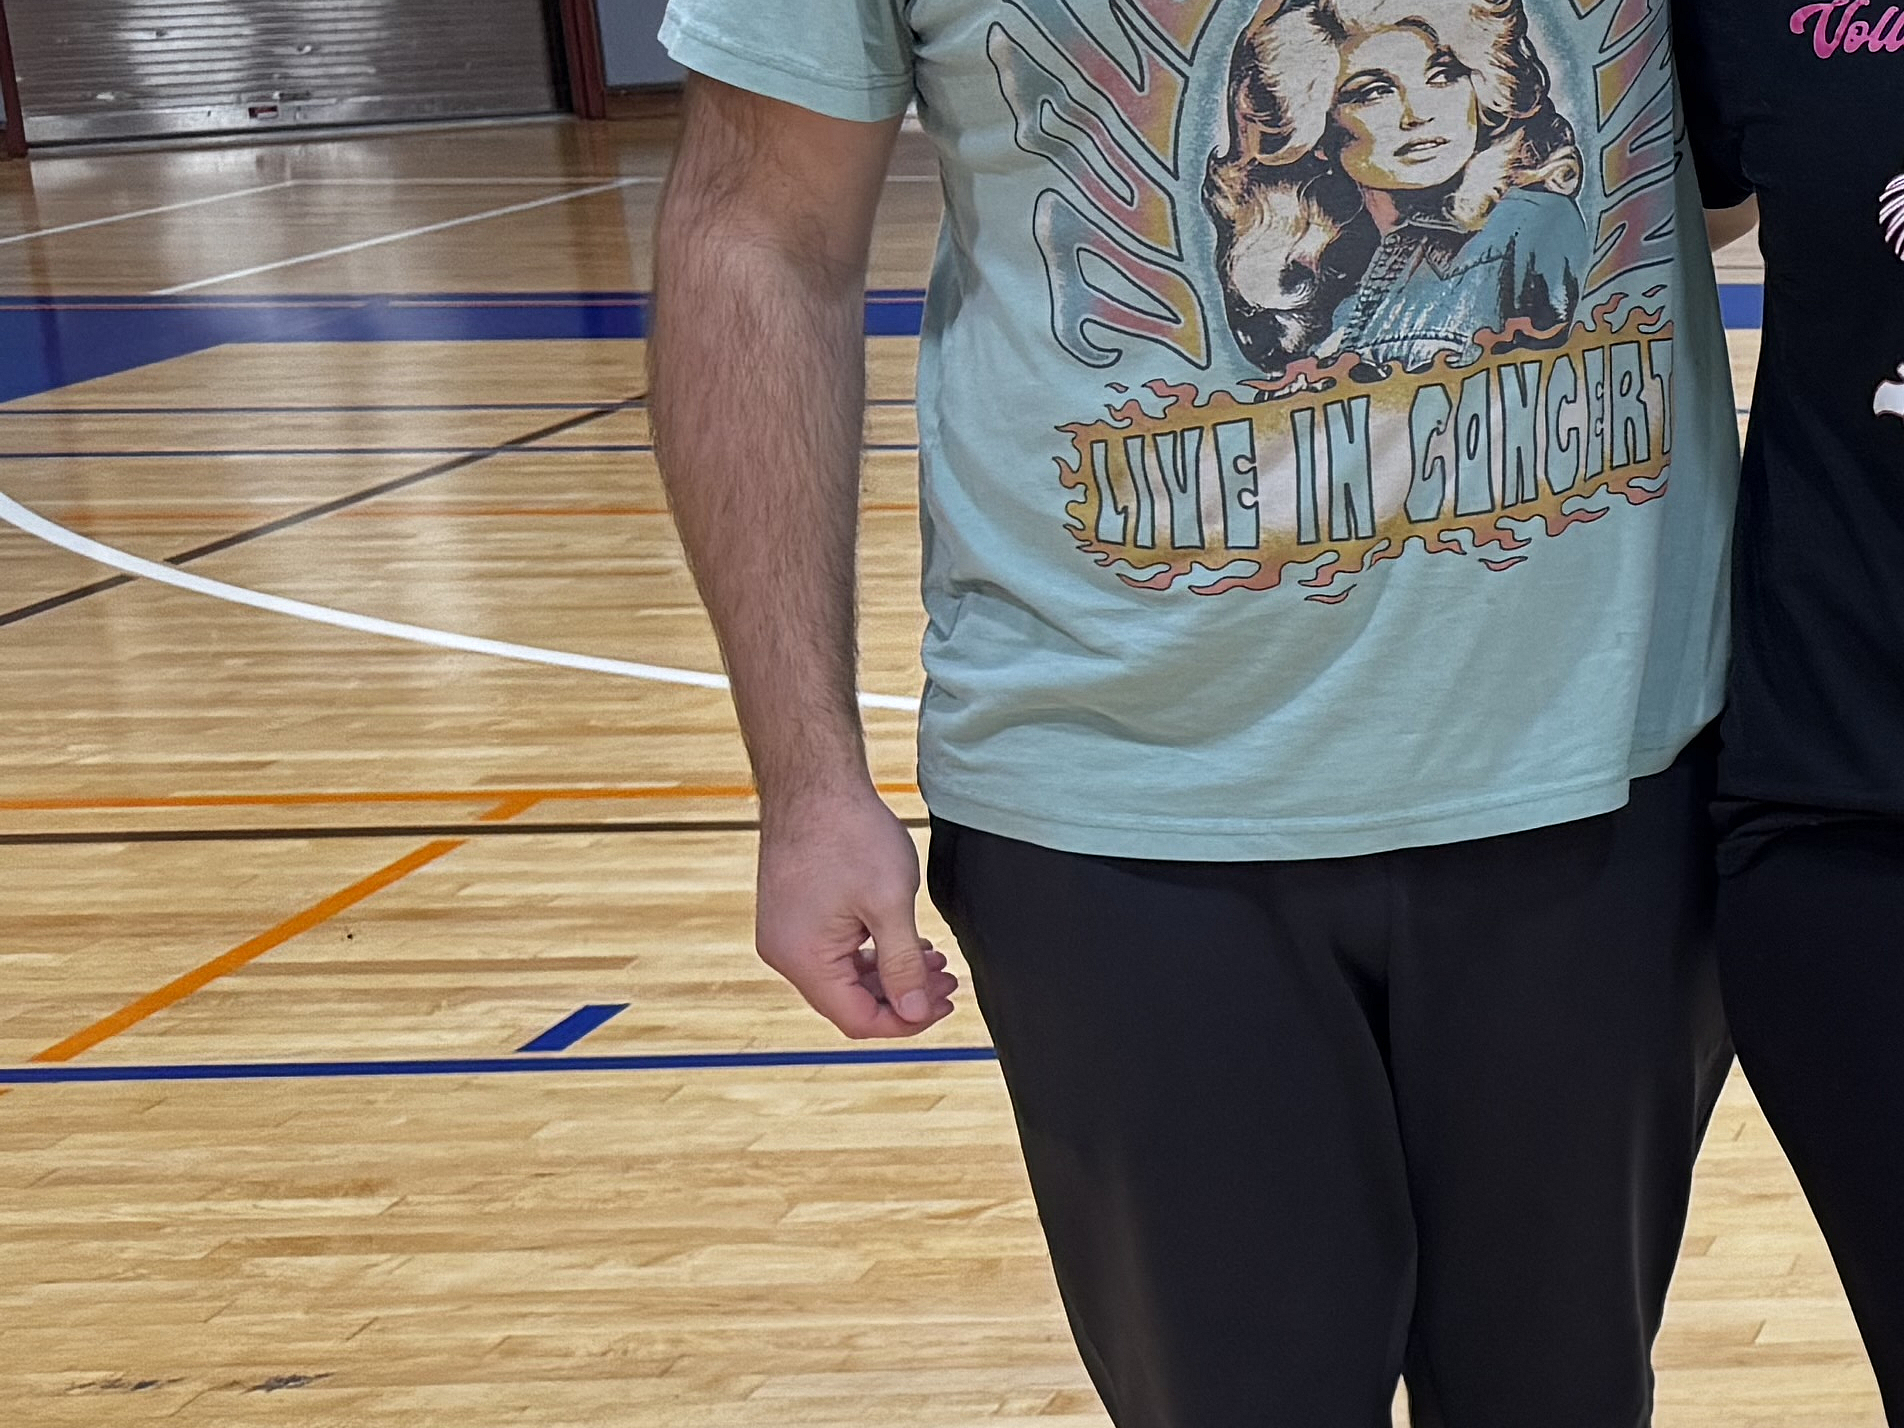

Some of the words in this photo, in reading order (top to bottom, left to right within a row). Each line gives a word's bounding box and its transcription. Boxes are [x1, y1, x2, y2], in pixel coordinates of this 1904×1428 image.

[1089, 419, 1260, 549] LIVE
[1290, 394, 1375, 545] IN
[1405, 337, 1673, 524] CONCERT
